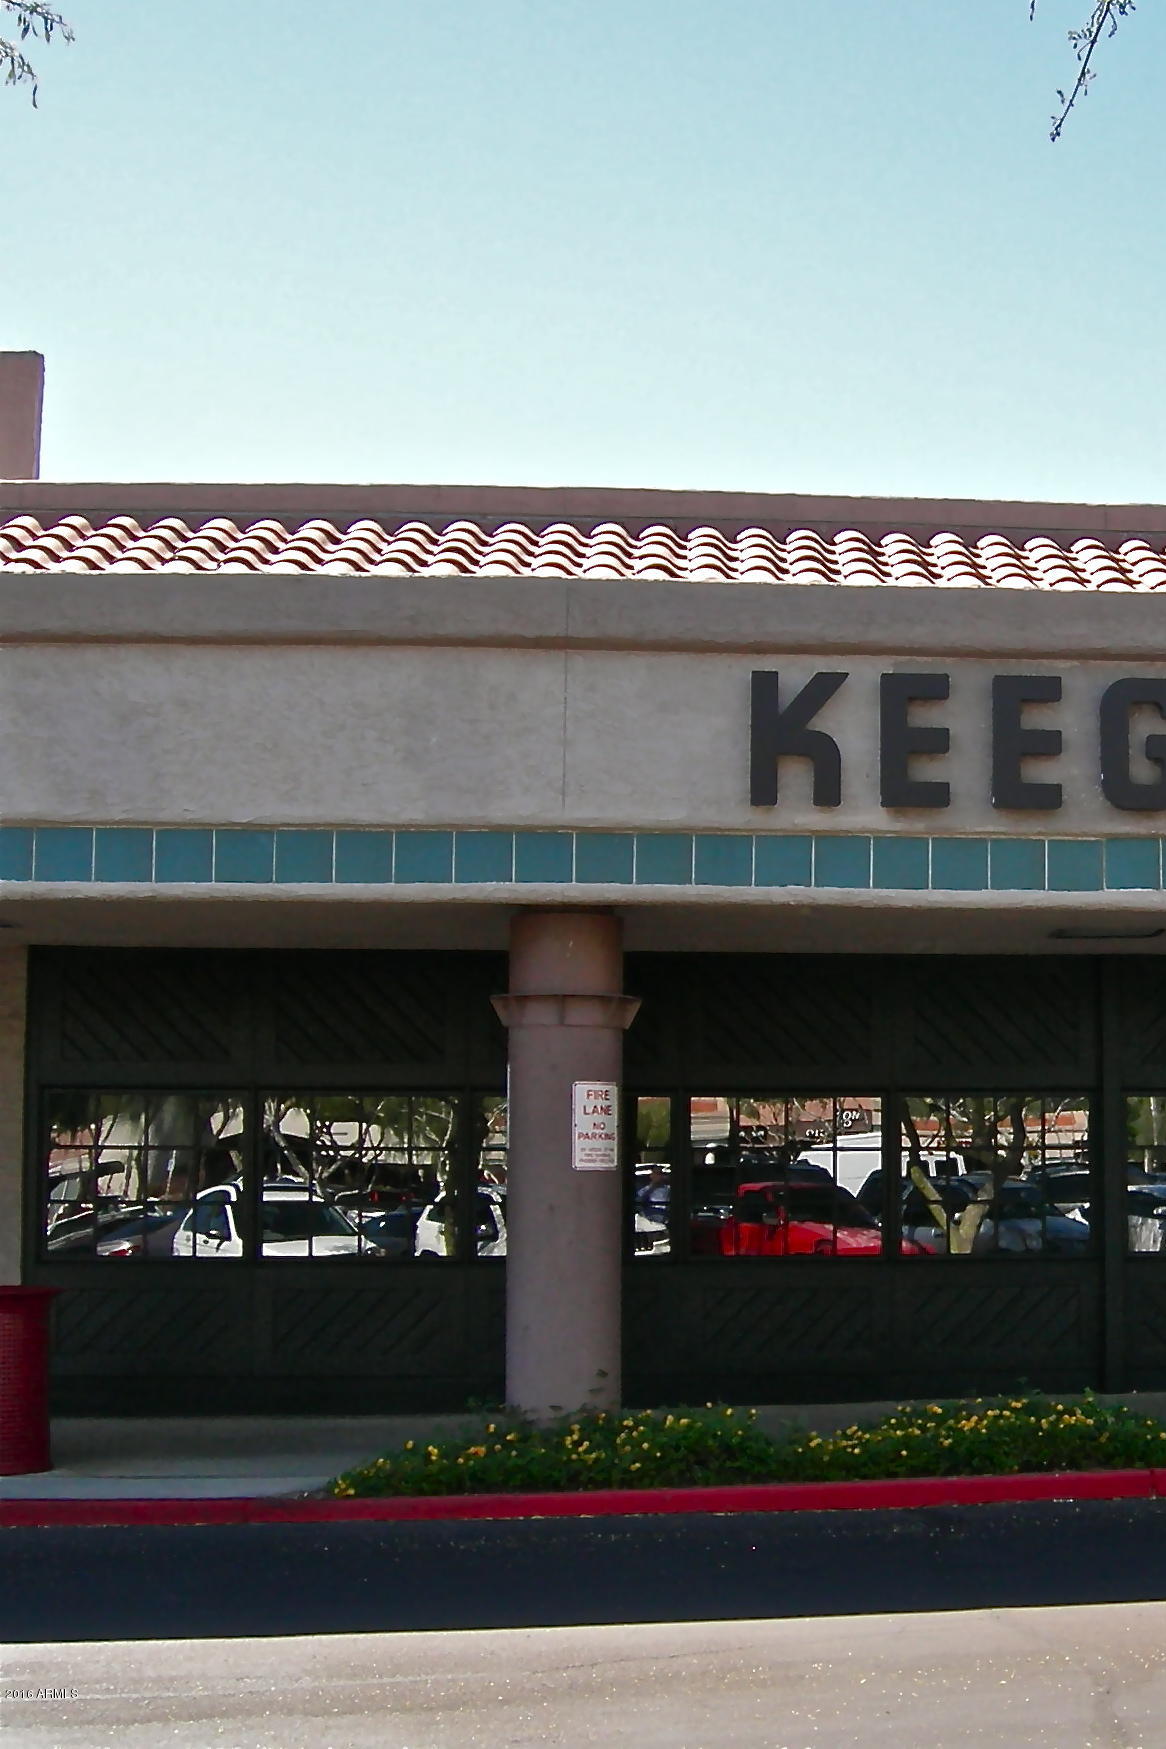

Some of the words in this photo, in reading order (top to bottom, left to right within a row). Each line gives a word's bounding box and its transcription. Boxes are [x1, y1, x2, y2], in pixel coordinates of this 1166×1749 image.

[586, 1089, 610, 1101] FIRE
[583, 1105, 612, 1116] LANE
[592, 1122, 606, 1131] NO
[577, 1132, 616, 1141] PARKING
